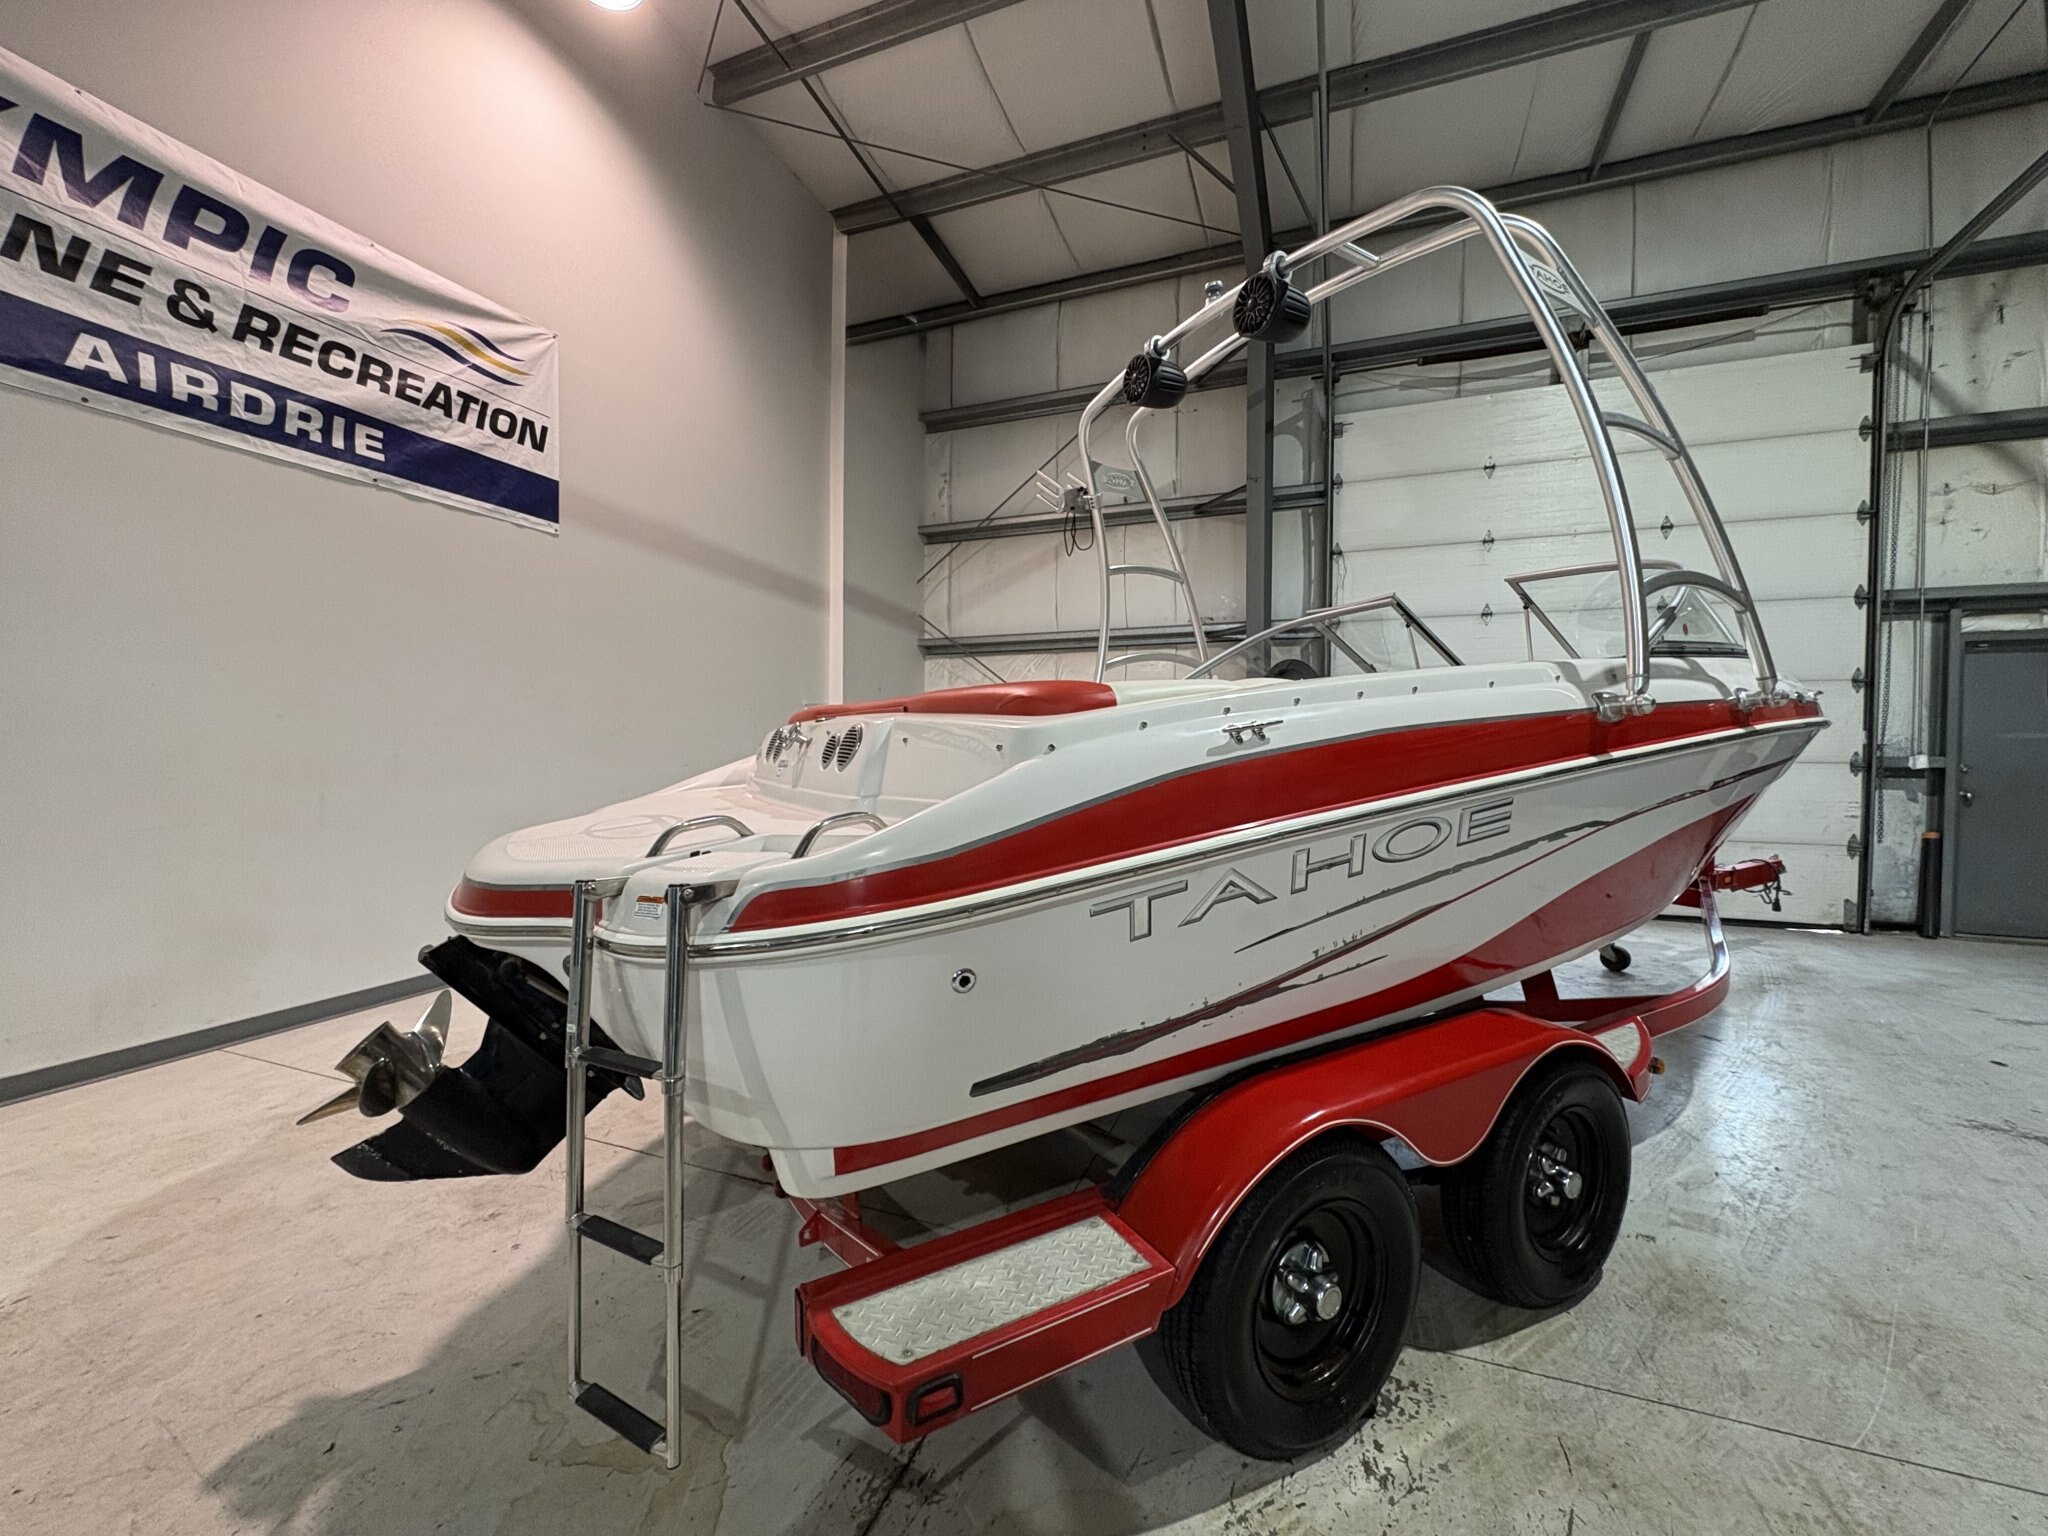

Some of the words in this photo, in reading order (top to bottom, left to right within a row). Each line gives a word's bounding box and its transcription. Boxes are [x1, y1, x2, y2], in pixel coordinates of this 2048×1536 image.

[0, 96, 356, 312] MPIC
[64, 332, 386, 462] AIRDRIE
[166, 278, 218, 333] &
[232, 303, 549, 453] RECREATION
[1090, 798, 1514, 942] TAHOE
